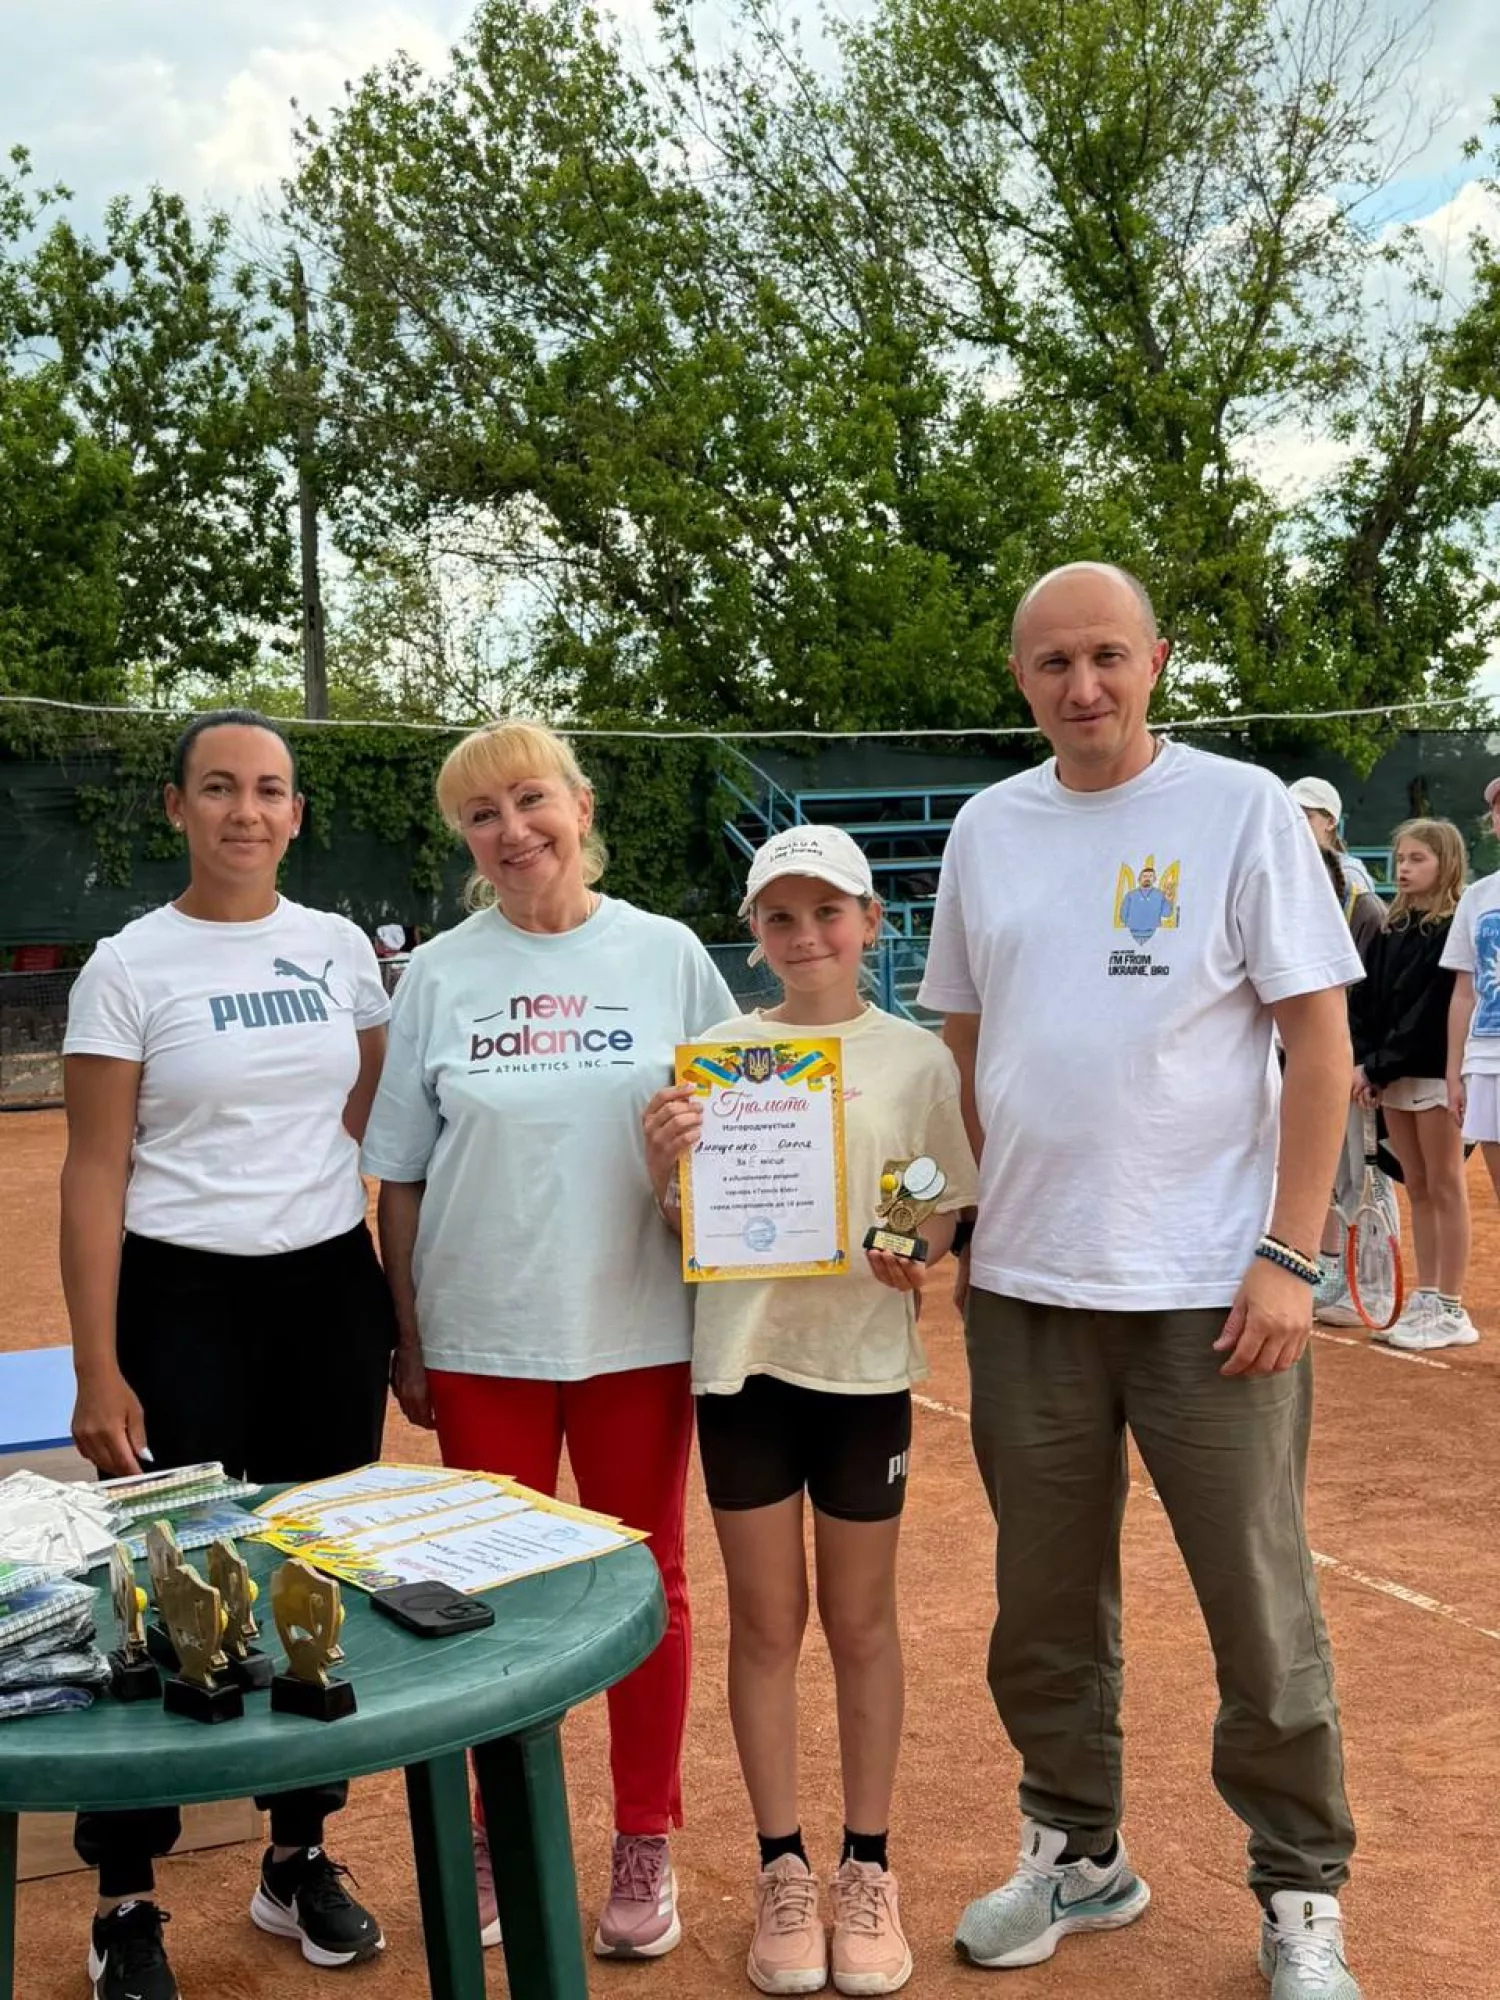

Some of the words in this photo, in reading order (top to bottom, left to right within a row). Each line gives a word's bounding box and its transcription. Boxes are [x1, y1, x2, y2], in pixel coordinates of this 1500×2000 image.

[1125, 954, 1151, 964] FROM
[1151, 965, 1169, 976] BRO
[209, 989, 329, 1031] PUMA
[509, 993, 588, 1020] new
[470, 1025, 633, 1061] balance
[495, 1062, 569, 1074] ATHLETICS
[712, 1091, 809, 1121] Грамота
